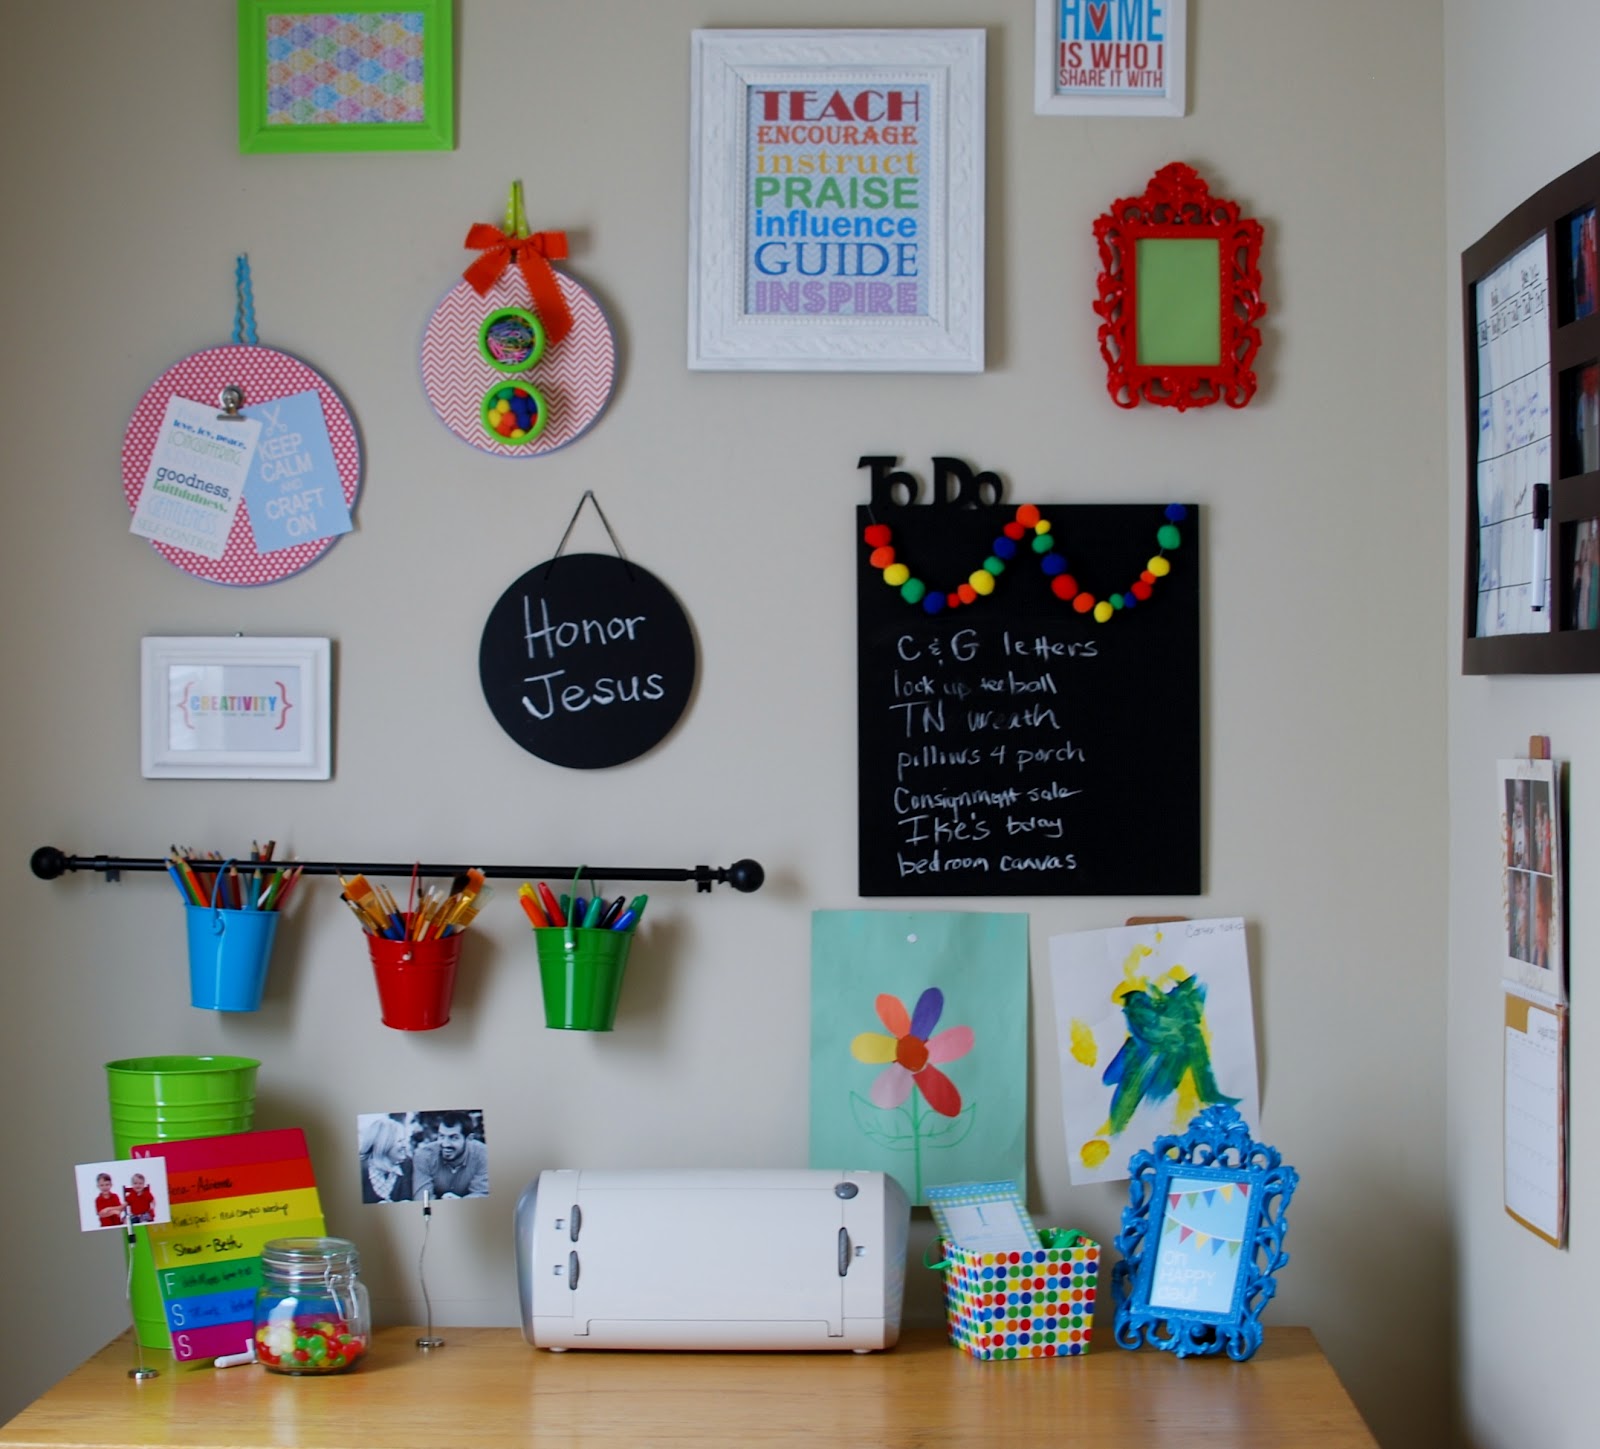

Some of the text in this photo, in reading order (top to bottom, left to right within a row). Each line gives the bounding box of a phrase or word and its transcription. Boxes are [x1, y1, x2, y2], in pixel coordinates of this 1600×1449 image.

[1060, 42, 1163, 69] IS WHO I
[1060, 69, 1163, 88] SHARE IT WITH
[755, 89, 919, 122] TEACH
[756, 125, 919, 145] ENCOURAGE
[755, 145, 921, 175] instruct
[754, 176, 919, 209] PRAISE
[755, 209, 918, 238] influence
[754, 241, 919, 277] GUIDE
[755, 281, 918, 314] INSPIRE
[259, 433, 302, 463] KEEP
[260, 452, 313, 482] CALM
[857, 456, 1003, 508] To Do
[156, 466, 232, 501] goodness,
[265, 487, 324, 520] CRAFT
[287, 513, 317, 537] ON
[524, 595, 646, 658] Honor
[898, 635, 921, 661] C
[951, 629, 980, 661] G
[1003, 631, 1099, 663] letters
[522, 669, 664, 720] Jesus
[889, 699, 946, 738] TN
[989, 745, 1006, 765] 4
[1016, 740, 1086, 772] porch
[898, 811, 991, 846] Ike's
[897, 849, 1077, 877] bedroom canvas
[164, 1273, 175, 1295] F
[172, 1304, 185, 1326] S
[177, 1335, 192, 1357] S
